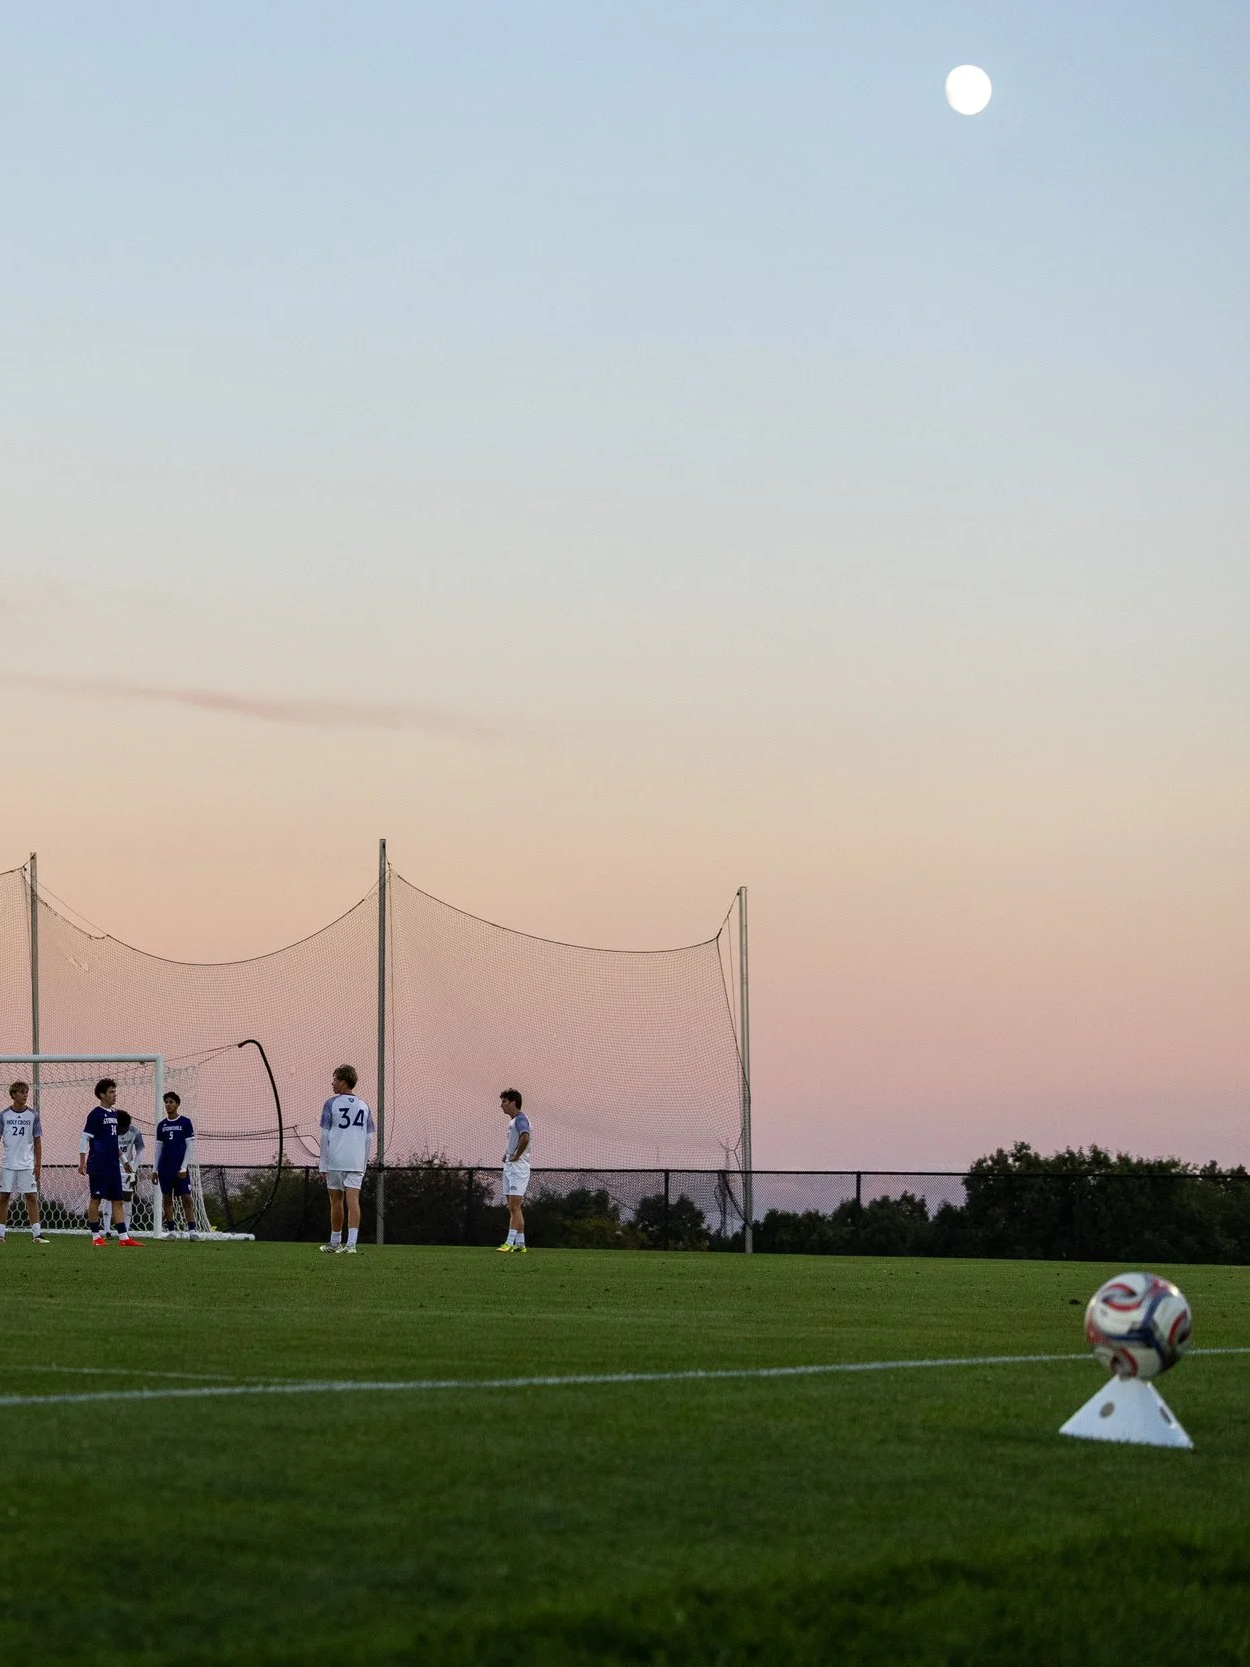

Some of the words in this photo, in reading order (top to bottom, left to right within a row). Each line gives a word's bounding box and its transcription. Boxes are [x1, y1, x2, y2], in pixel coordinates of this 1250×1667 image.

[338, 1107, 365, 1130] 34
[12, 1126, 26, 1137] 24
[168, 1131, 174, 1140] 5
